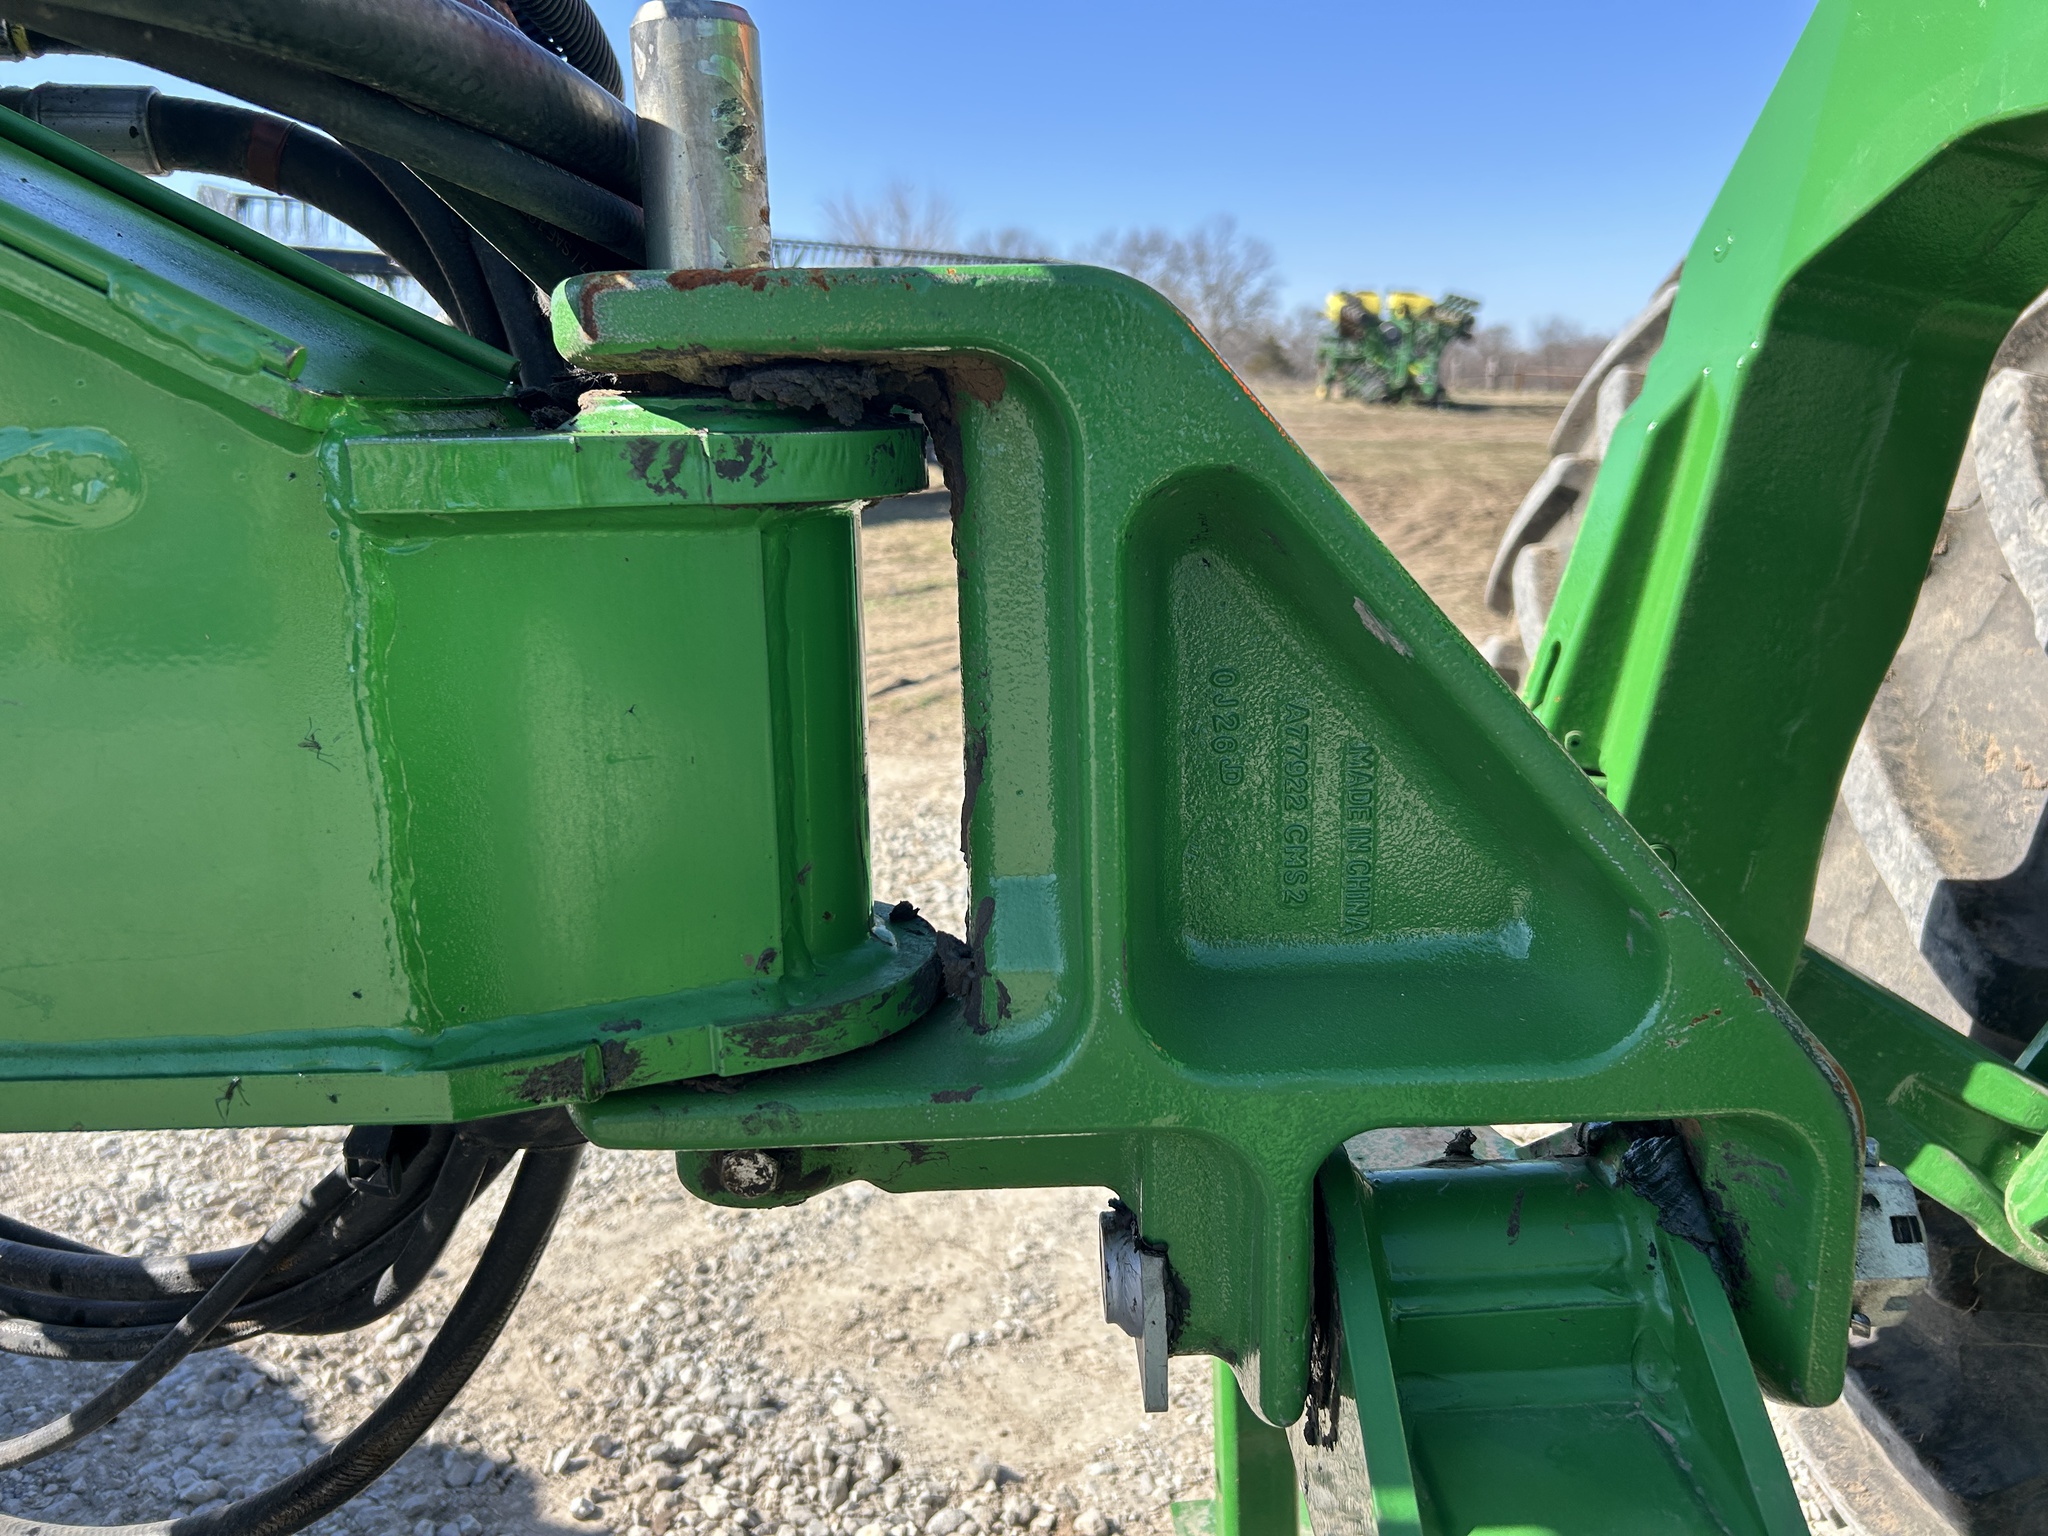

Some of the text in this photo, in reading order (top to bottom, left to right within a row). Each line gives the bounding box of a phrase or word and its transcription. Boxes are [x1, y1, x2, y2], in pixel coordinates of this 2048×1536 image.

[1284, 703, 1310, 811] A77922
[1344, 744, 1374, 935] MADE IN CHINA
